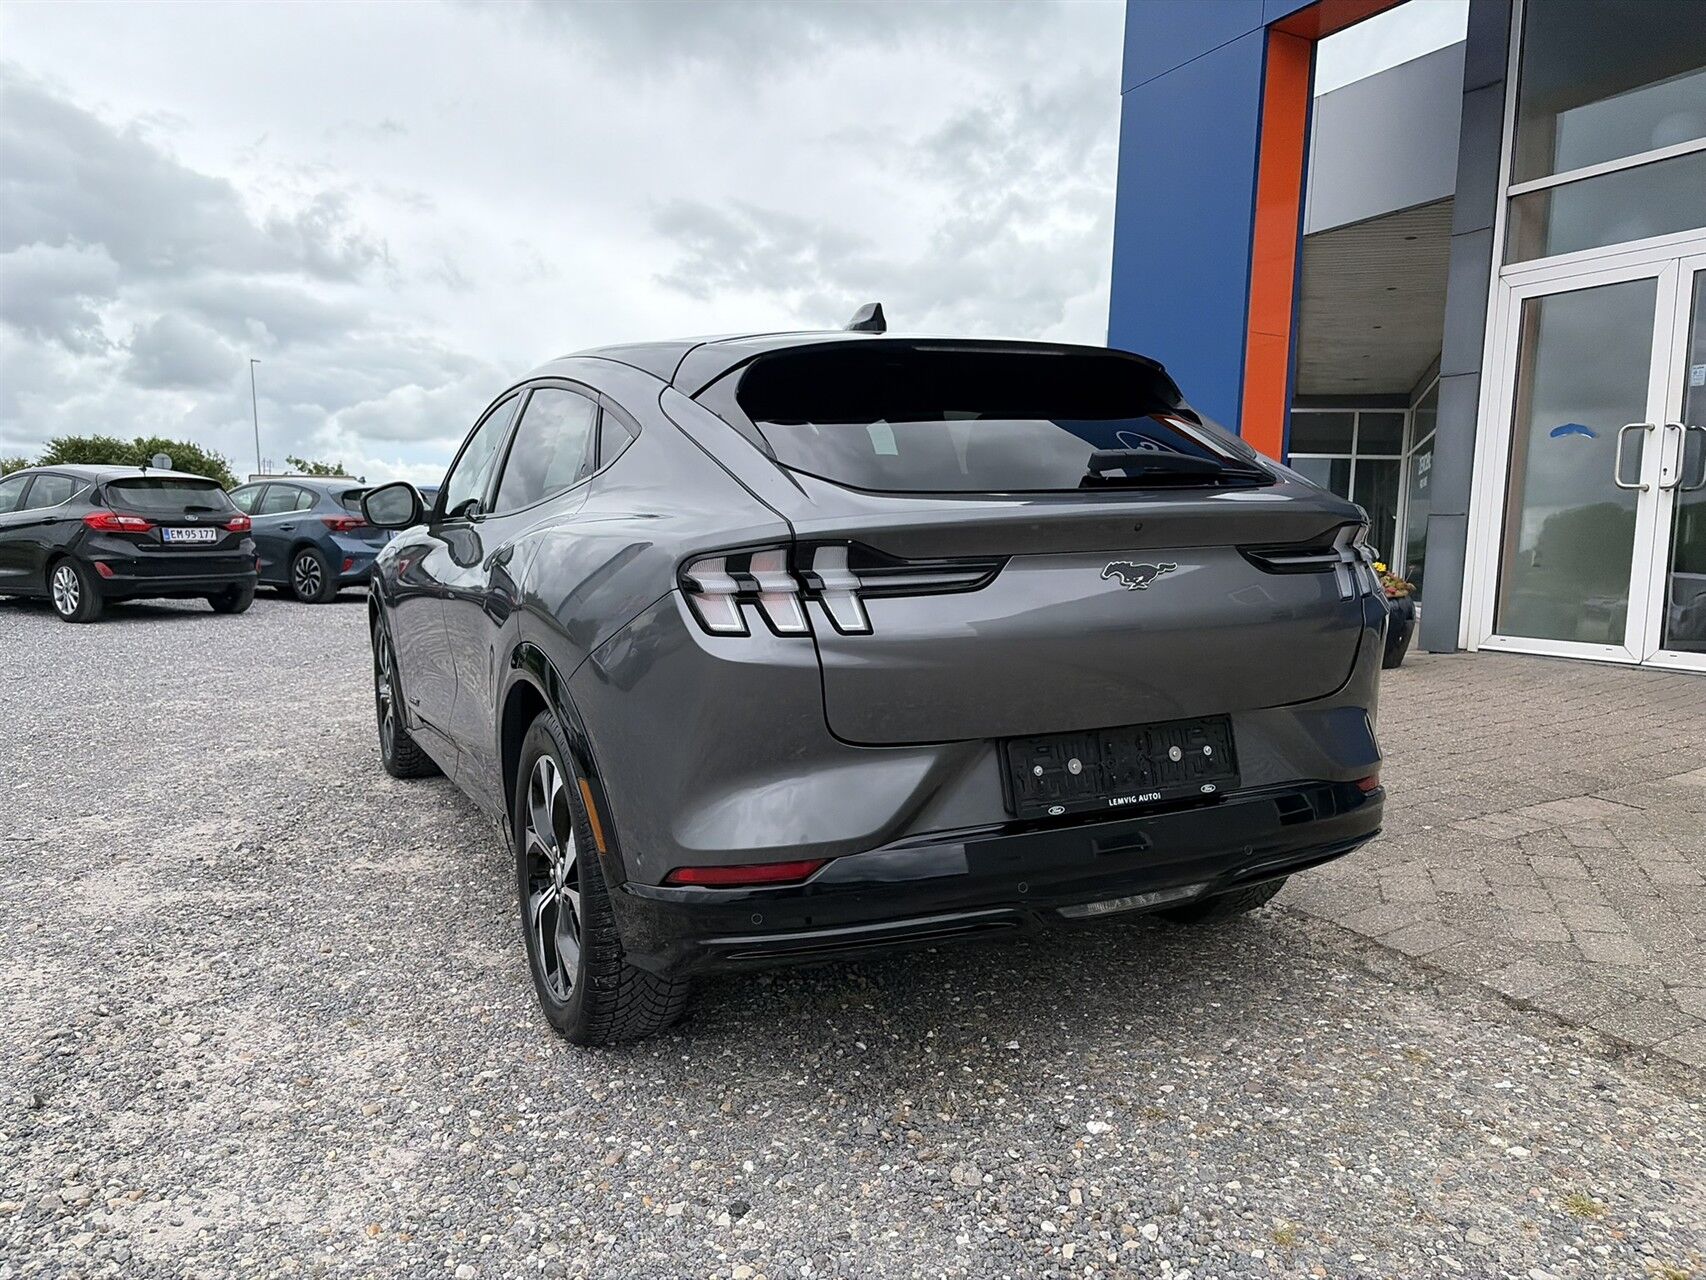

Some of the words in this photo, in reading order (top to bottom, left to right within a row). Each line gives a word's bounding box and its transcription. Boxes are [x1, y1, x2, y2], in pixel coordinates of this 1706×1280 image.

[171, 529, 184, 539] EM
[185, 529, 197, 539] 95
[199, 529, 214, 539] 177
[1108, 795, 1137, 807] LEMVIG
